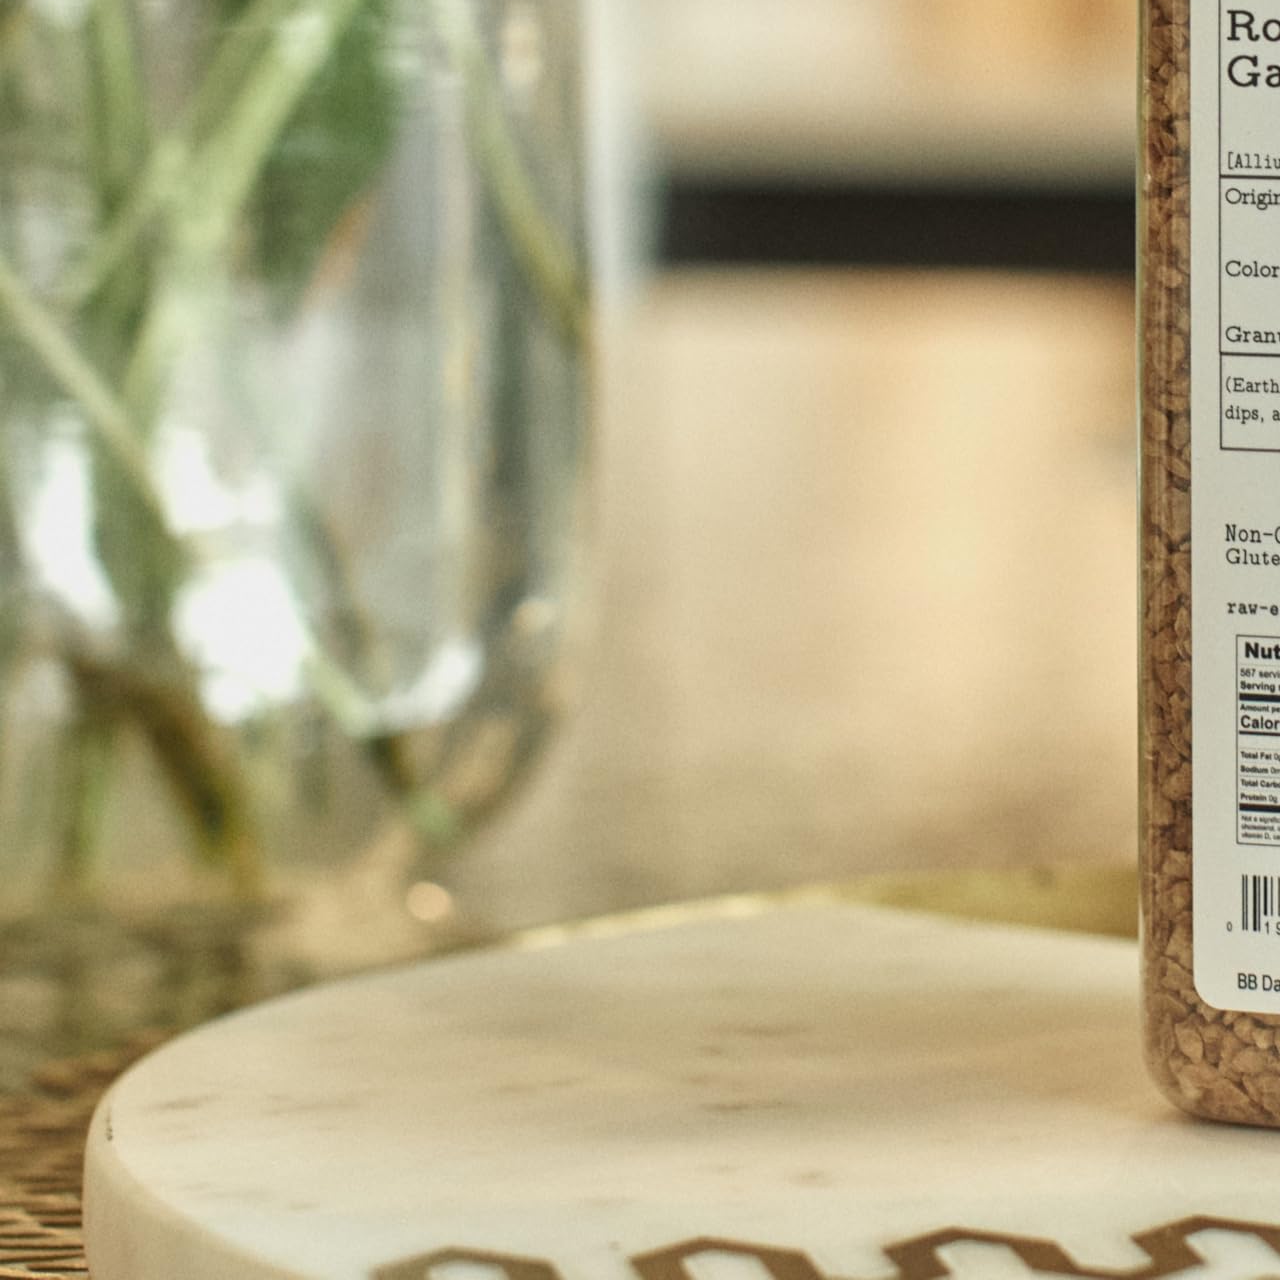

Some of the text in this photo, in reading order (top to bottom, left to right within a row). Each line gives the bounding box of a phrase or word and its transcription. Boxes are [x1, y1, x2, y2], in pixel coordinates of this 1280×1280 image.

[1225, 406, 1265, 423] dips,
[1240, 681, 1275, 692] Serving
[1237, 973, 1257, 992] BB
